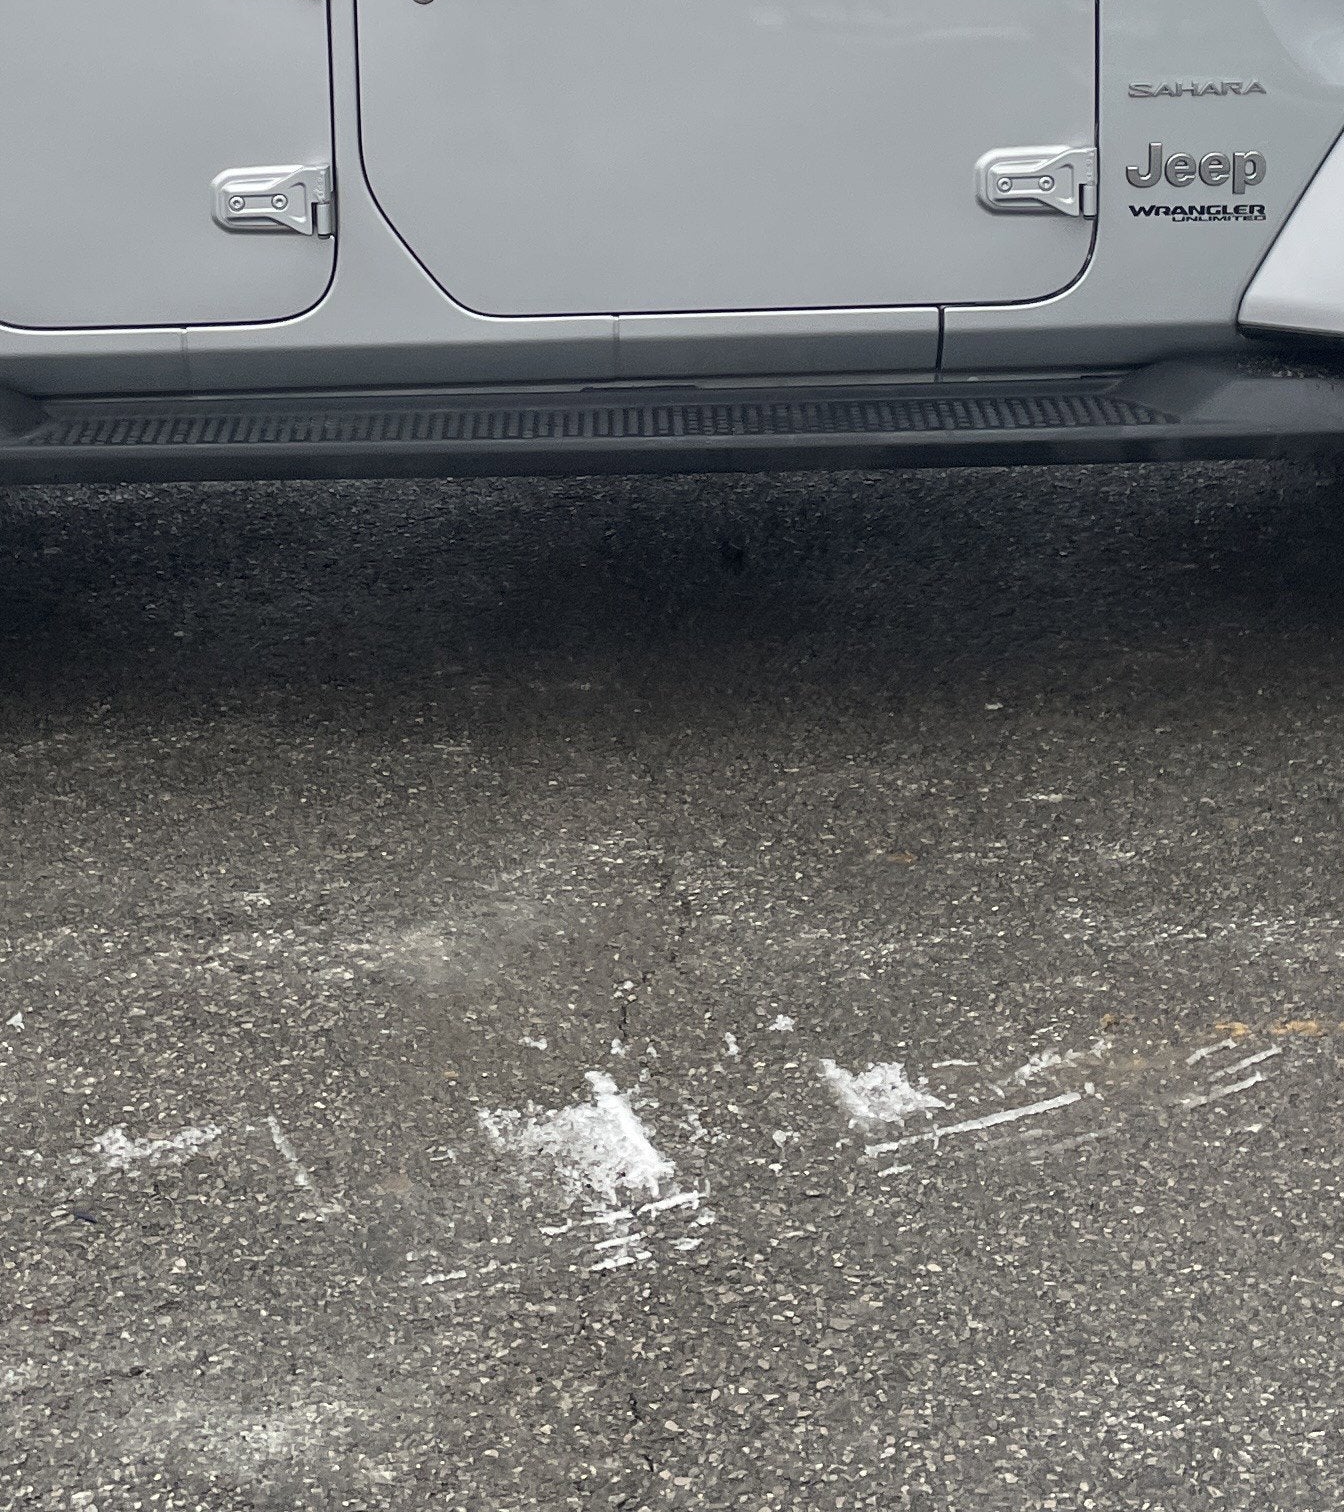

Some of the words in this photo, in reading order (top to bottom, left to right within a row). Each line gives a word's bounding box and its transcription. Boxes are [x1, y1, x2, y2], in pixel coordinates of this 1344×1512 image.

[1127, 80, 1267, 98] SAHARA
[1125, 141, 1267, 195] Jeep
[1128, 204, 1266, 217] WRANGLER
[1171, 215, 1267, 223] UNLIMITED
